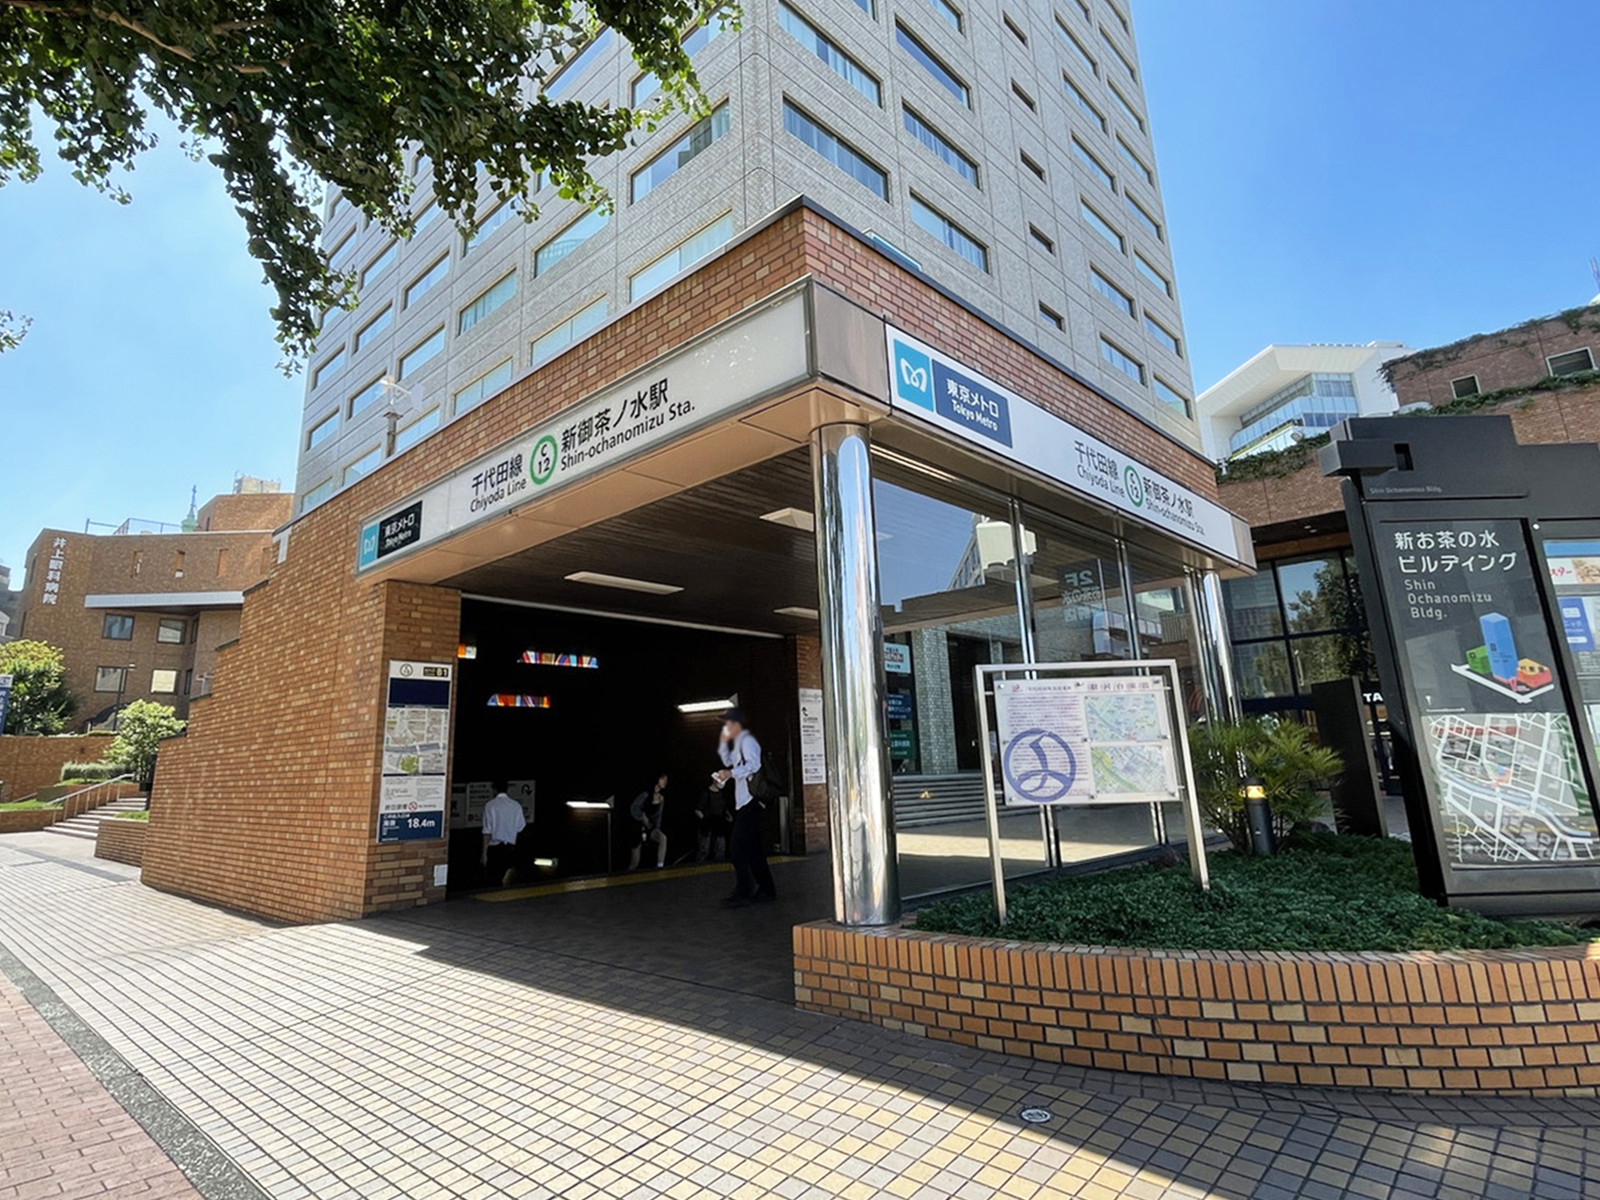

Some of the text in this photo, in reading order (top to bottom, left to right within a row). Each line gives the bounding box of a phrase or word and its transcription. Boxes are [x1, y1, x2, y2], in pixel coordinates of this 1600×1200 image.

[946, 378, 999, 418] 東京メトロ
[951, 398, 998, 431] Tokyo Metro
[561, 377, 669, 453] 新御茶ノ水駅
[561, 400, 696, 471] Shin-ochanomizu Sta.
[471, 453, 523, 496] 千代田線
[537, 457, 551, 475] 12
[1074, 440, 1120, 480] 千代田線
[470, 478, 528, 513] Chiyoda Line
[1394, 529, 1500, 550] 新お茶の水
[42, 537, 67, 605] 井上眼科病院
[1398, 552, 1517, 573] ビルディング
[1404, 579, 1436, 590] Shin
[1407, 592, 1492, 604] Ochanomizu
[1410, 607, 1448, 620] Bldg.
[407, 818, 436, 829] 18.4m
